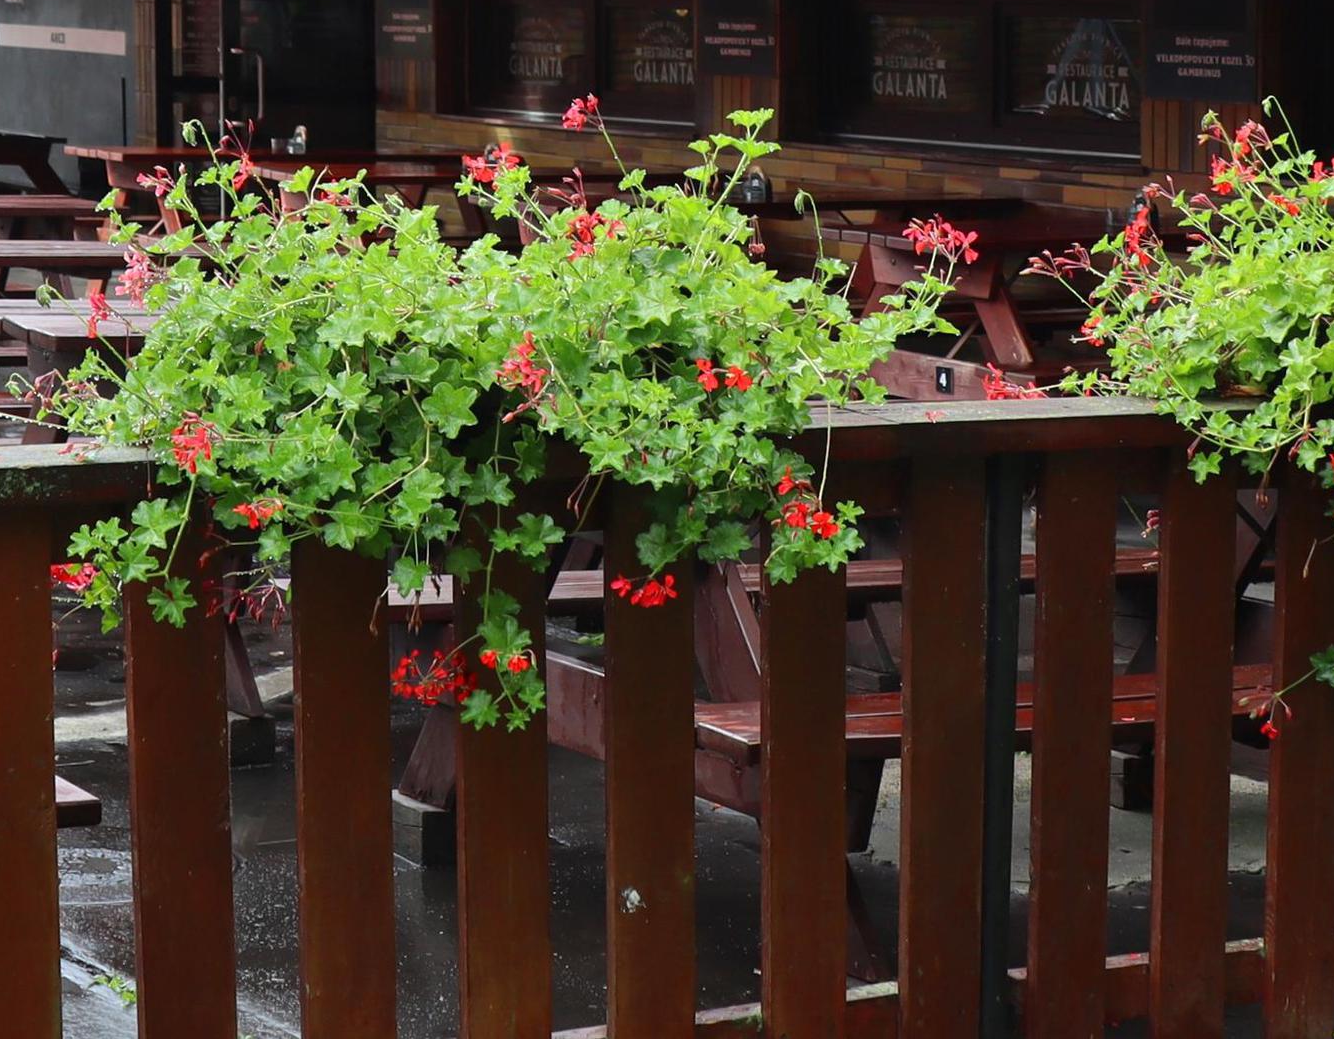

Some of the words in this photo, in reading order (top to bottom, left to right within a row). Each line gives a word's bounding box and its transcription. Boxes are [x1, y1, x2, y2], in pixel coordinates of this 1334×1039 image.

[509, 55, 564, 79] GALANTA
[634, 60, 695, 86] GALANTA
[1058, 63, 1115, 79] RESTAURACE
[1177, 68, 1221, 78] GAMBRINUS
[873, 71, 947, 99] GALANTA
[1045, 79, 1130, 109] GALANTA
[938, 372, 948, 388] 4
